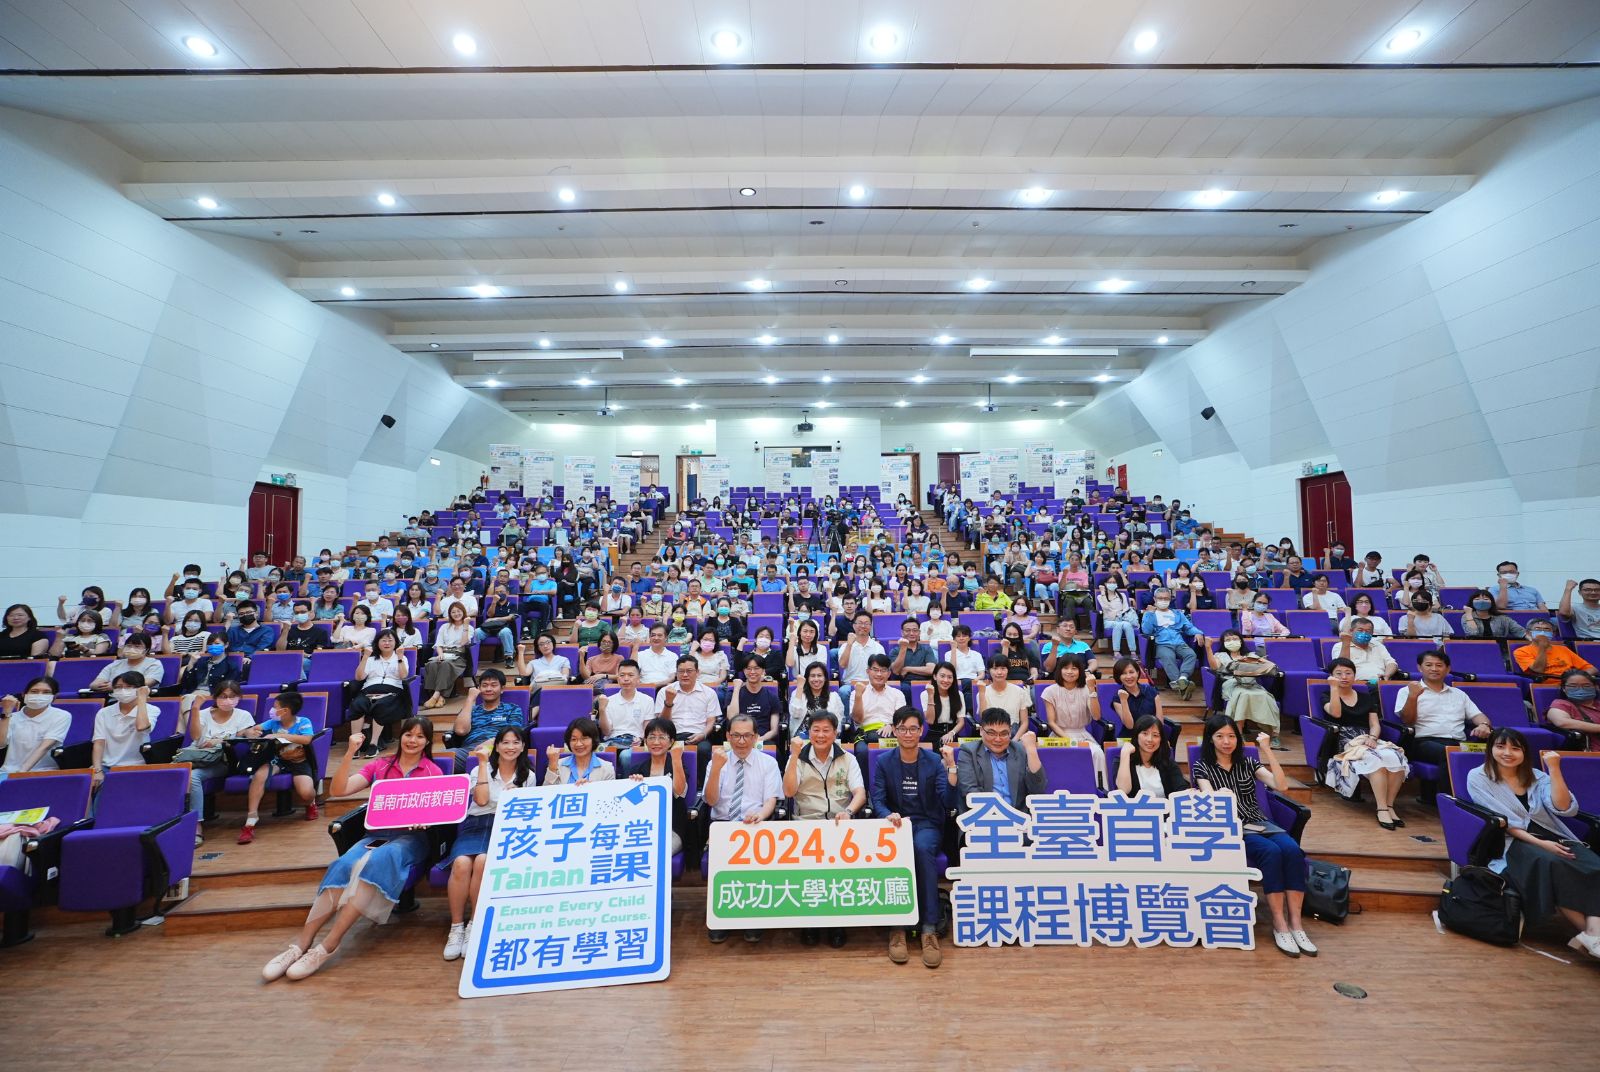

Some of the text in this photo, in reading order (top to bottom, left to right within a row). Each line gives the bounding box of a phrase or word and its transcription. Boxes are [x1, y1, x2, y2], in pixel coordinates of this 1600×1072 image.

[372, 789, 465, 811] 臺南市政府教育局
[502, 792, 589, 821] 每個
[496, 822, 587, 863] 孩子
[590, 819, 654, 851] 每堂
[962, 795, 1241, 862] 全臺首學
[728, 827, 898, 865] 2024.6.5
[489, 865, 585, 892] Tainan
[590, 851, 652, 886] 課
[499, 895, 646, 917] Ensure Every Child
[717, 876, 912, 910] 成功大學格致廳
[497, 911, 651, 932] Learn in Every Course.
[955, 883, 1254, 946] 課程博覽會
[490, 927, 649, 972] 都有學習
